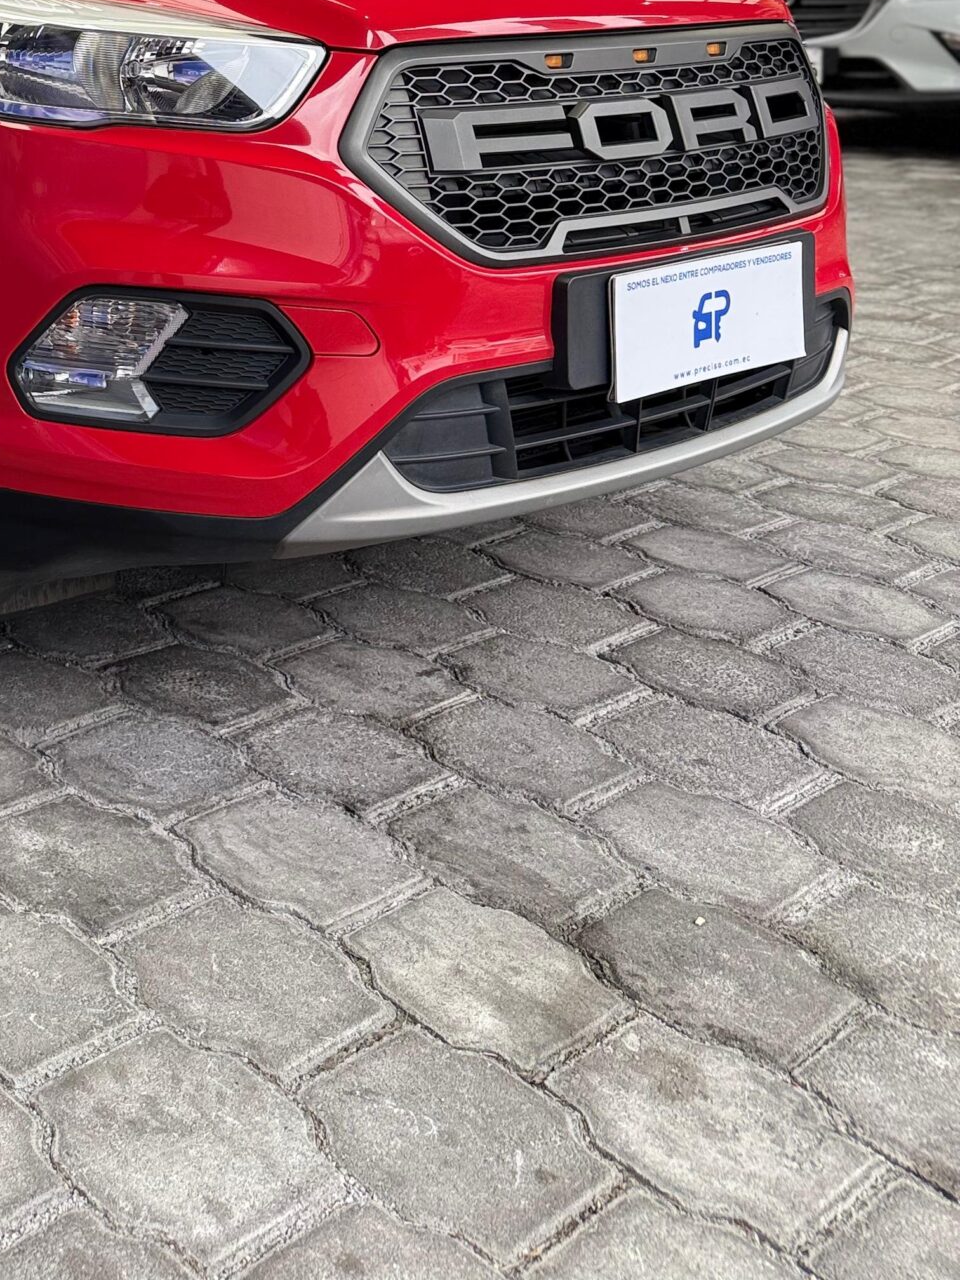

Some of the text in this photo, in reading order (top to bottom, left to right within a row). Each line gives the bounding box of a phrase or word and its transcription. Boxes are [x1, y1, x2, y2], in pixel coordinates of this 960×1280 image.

[418, 77, 820, 172] FORD
[626, 251, 792, 291] SOMOS EL NEXO ENTRE COMPRADORES Y VENDEDORES
